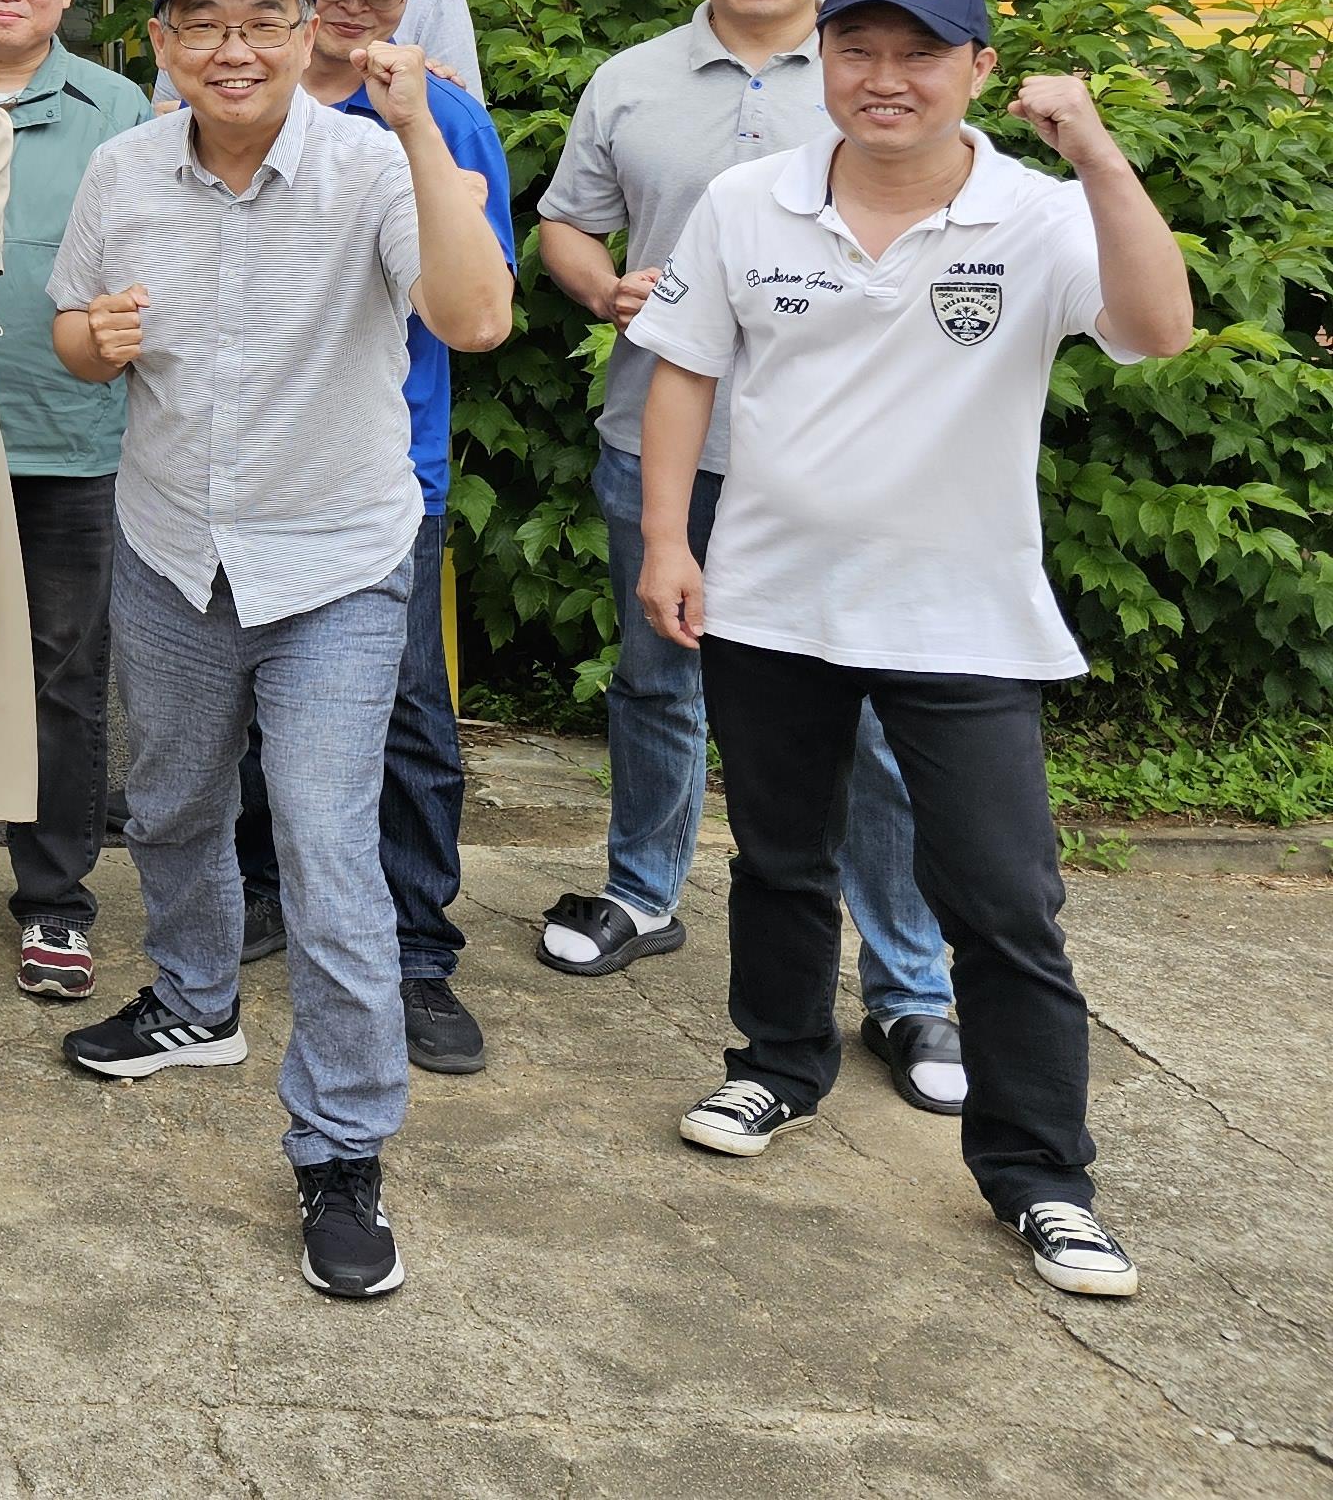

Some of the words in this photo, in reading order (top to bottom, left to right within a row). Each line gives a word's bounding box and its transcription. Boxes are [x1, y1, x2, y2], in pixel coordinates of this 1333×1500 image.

[949, 262, 1005, 276] CKAROO
[805, 271, 844, 293] Jeans
[773, 297, 810, 314] 1950
